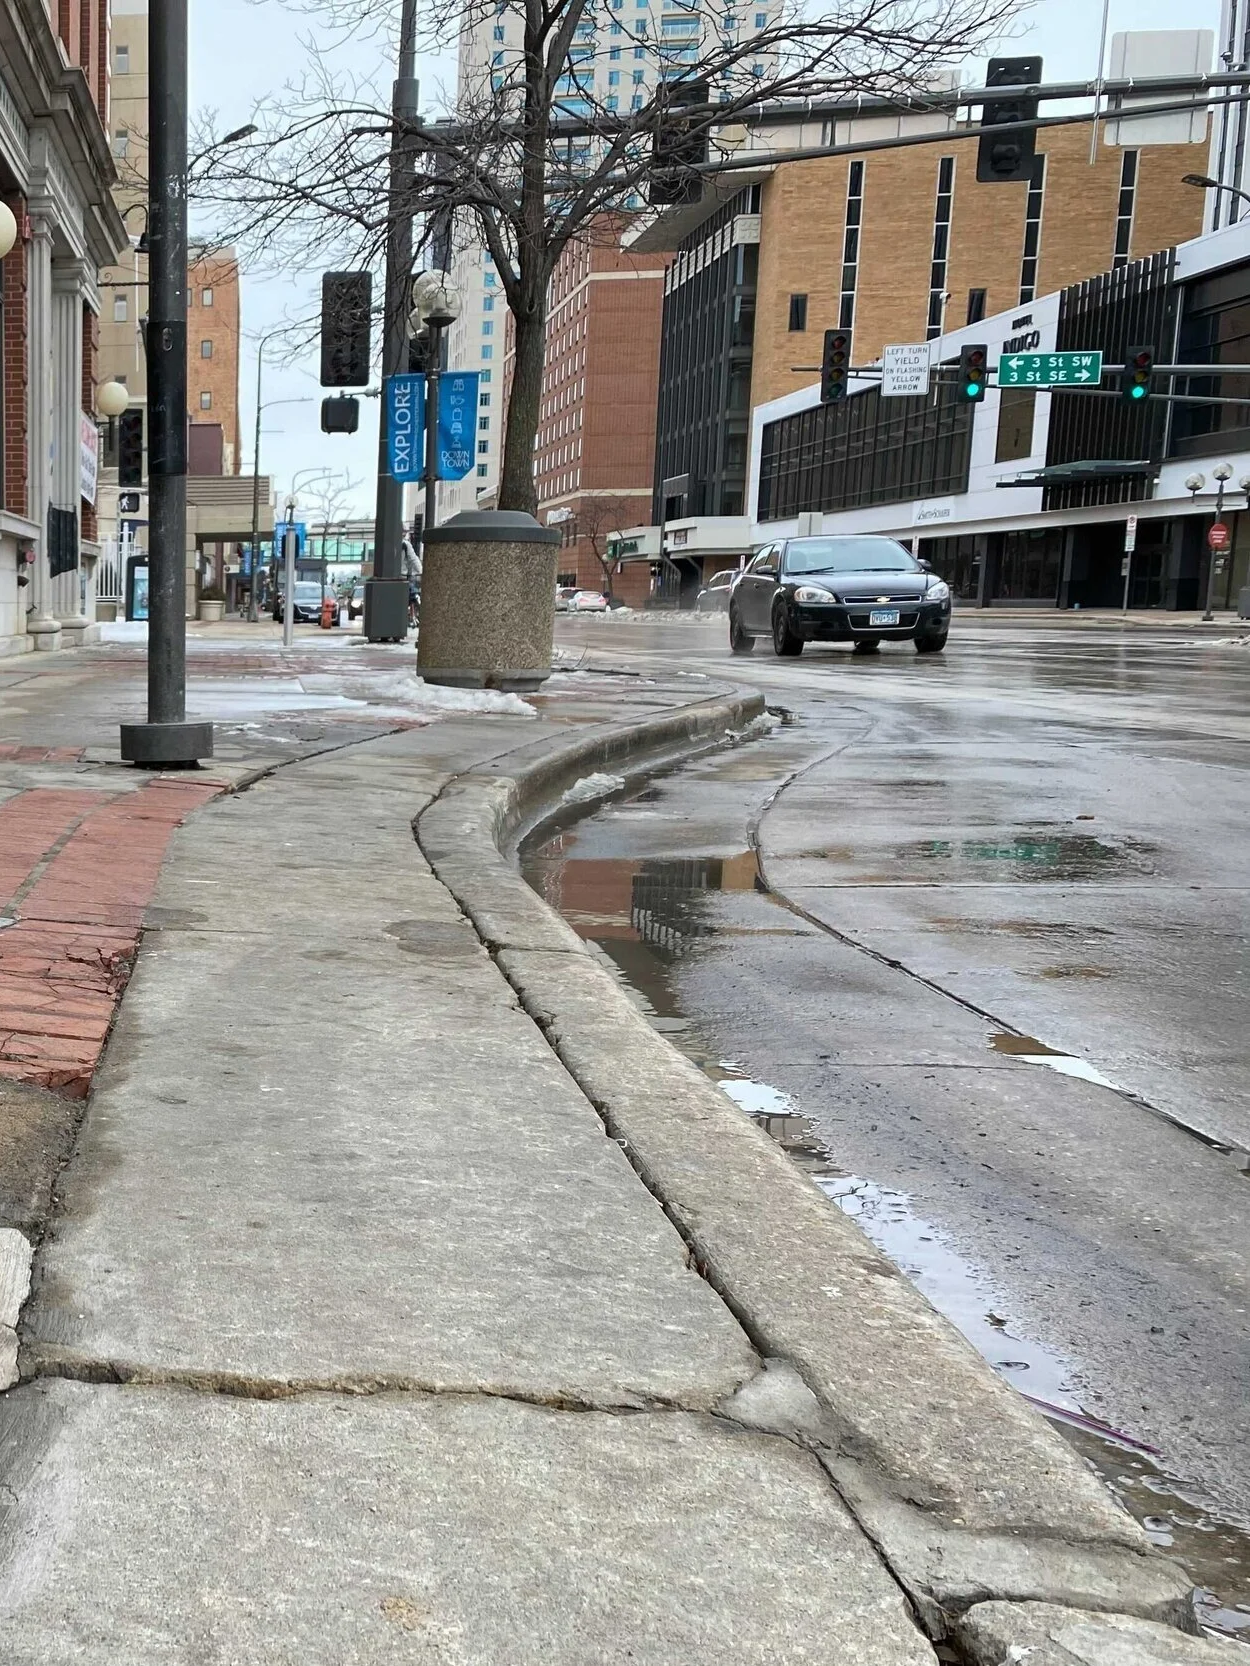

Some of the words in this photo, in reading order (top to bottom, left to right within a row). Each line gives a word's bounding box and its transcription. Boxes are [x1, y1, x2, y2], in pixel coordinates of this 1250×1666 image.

[894, 357, 920, 365] YIELD
[1031, 357, 1041, 368] 3
[1048, 356, 1064, 367] St
[1071, 355, 1092, 366] SW
[896, 366, 927, 374] FLASHING
[891, 375, 921, 383] YELLOW
[1009, 371, 1018, 382] 3
[1025, 371, 1041, 381] St
[1049, 370, 1067, 381] SE
[394, 382, 411, 473] EXPLORE
[441, 450, 470, 459] DOWN
[441, 459, 470, 468] TOWN
